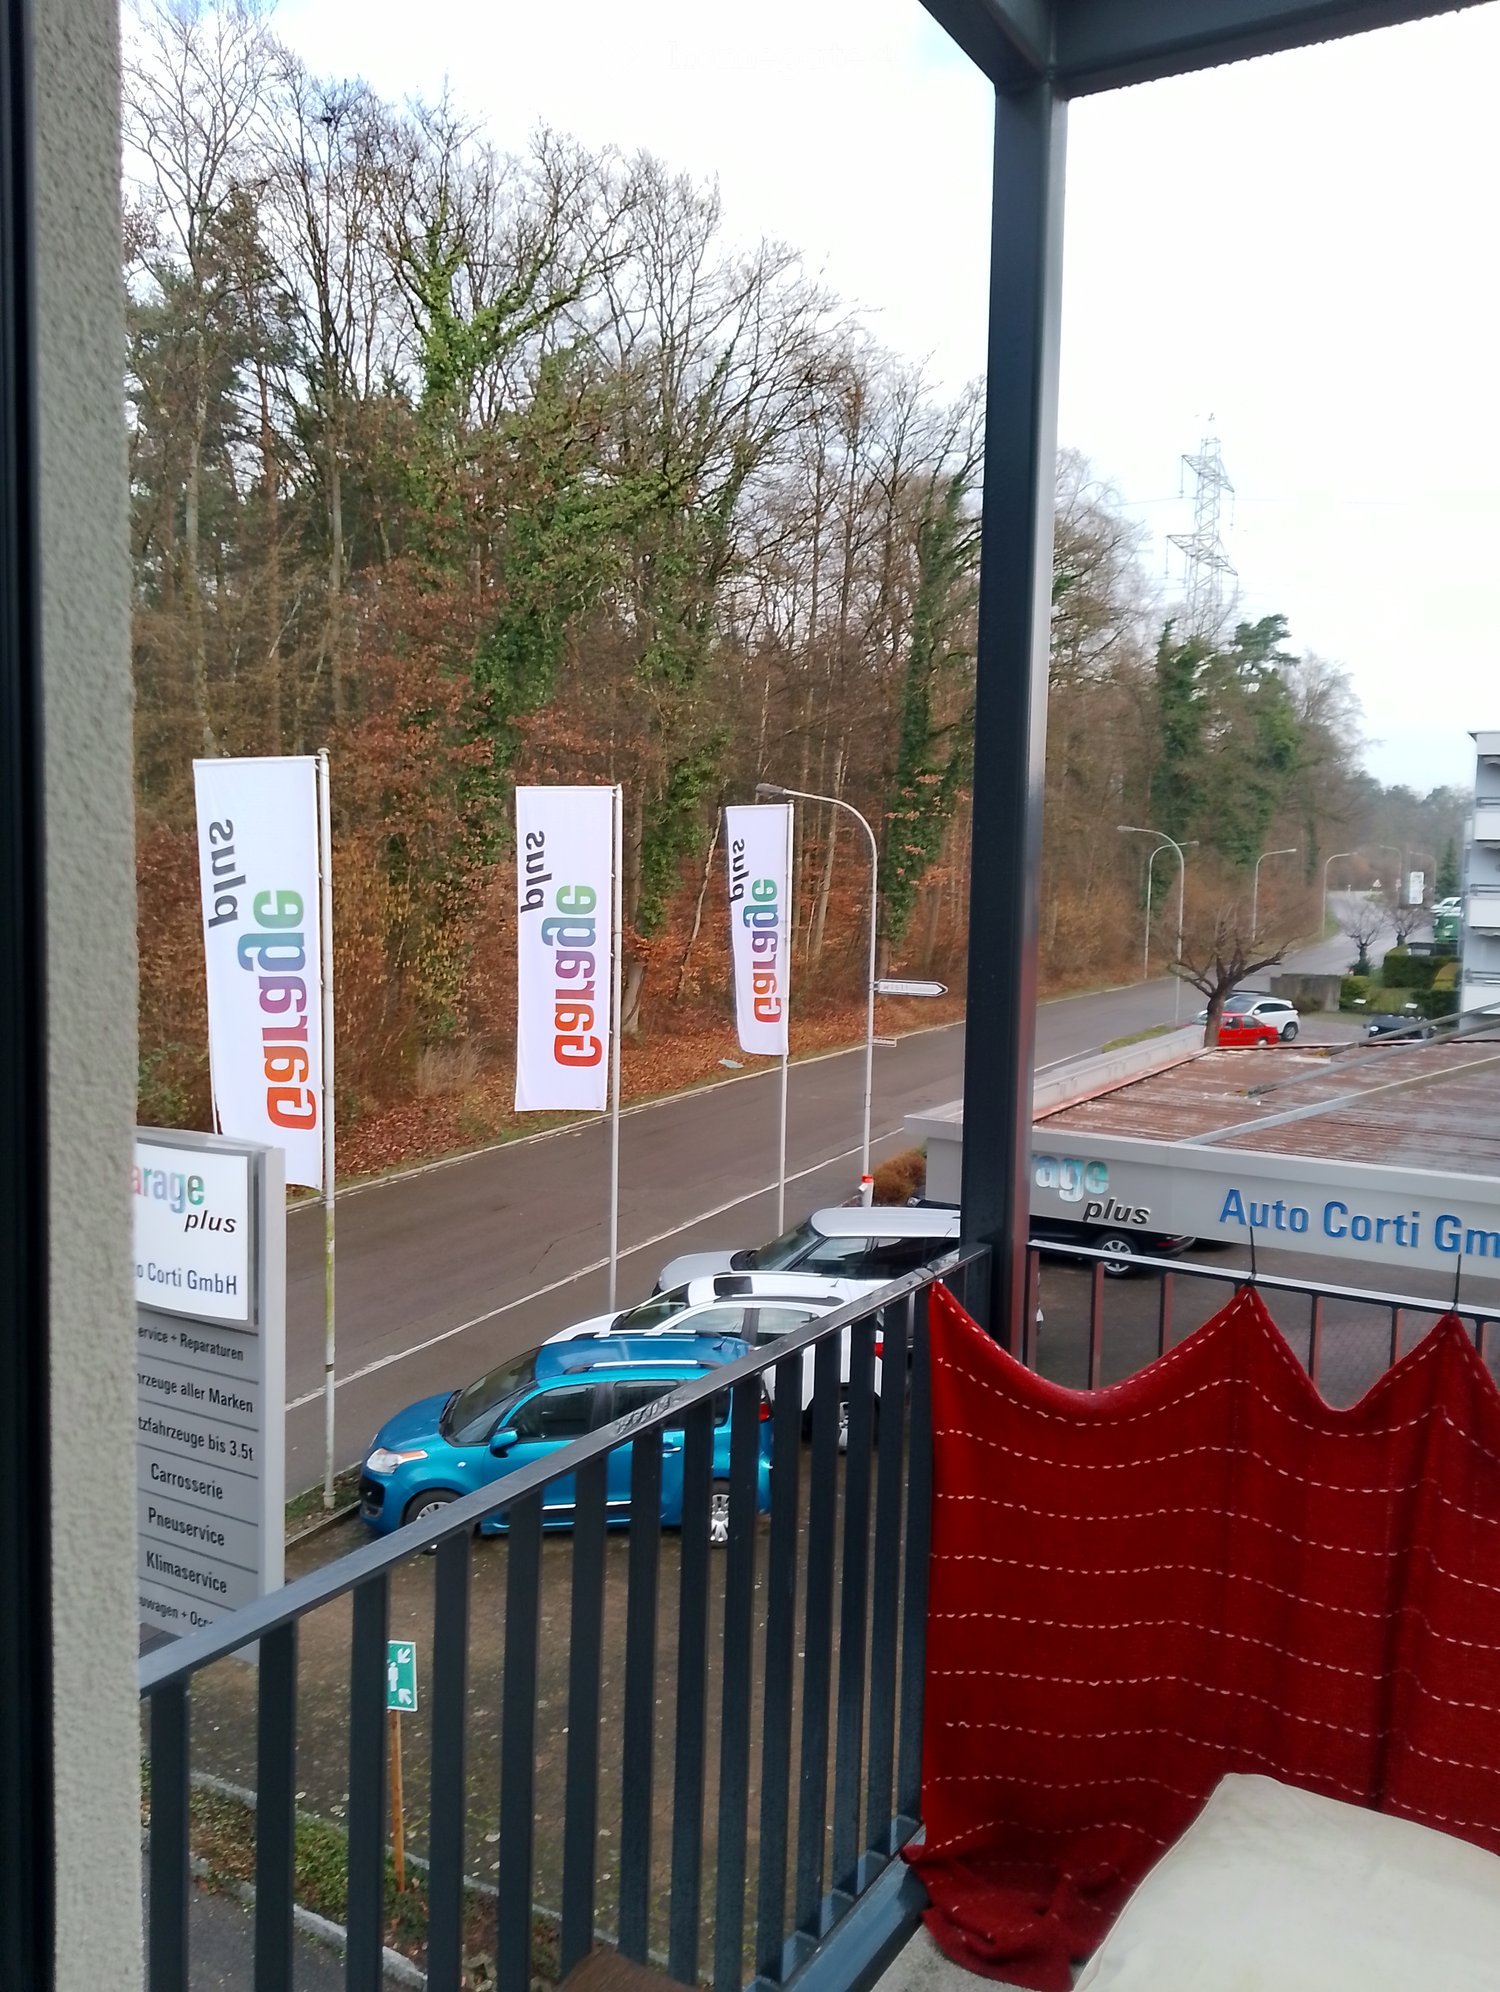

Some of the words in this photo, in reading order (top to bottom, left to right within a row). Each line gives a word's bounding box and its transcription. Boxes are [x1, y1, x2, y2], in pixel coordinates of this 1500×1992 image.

[1032, 1154, 1109, 1202] age
[184, 1209, 237, 1233] plus
[1083, 1197, 1151, 1225] plus
[1219, 1187, 1309, 1233] Auto
[1323, 1200, 1420, 1248] Corti
[1434, 1214, 1500, 1259] Gm
[147, 1262, 182, 1287] Corti
[187, 1269, 237, 1295] GmbH
[180, 1332, 244, 1361] Reparaturen
[180, 1382, 205, 1400] aller
[208, 1387, 253, 1413] Marken
[138, 1416, 205, 1449] tzfahrzeuge
[208, 1433, 226, 1454] bis
[229, 1439, 254, 1461] 3.5t
[151, 1462, 223, 1500] Carrosserie
[148, 1506, 225, 1546] Pneuservice
[146, 1550, 227, 1594] Klimaservice
